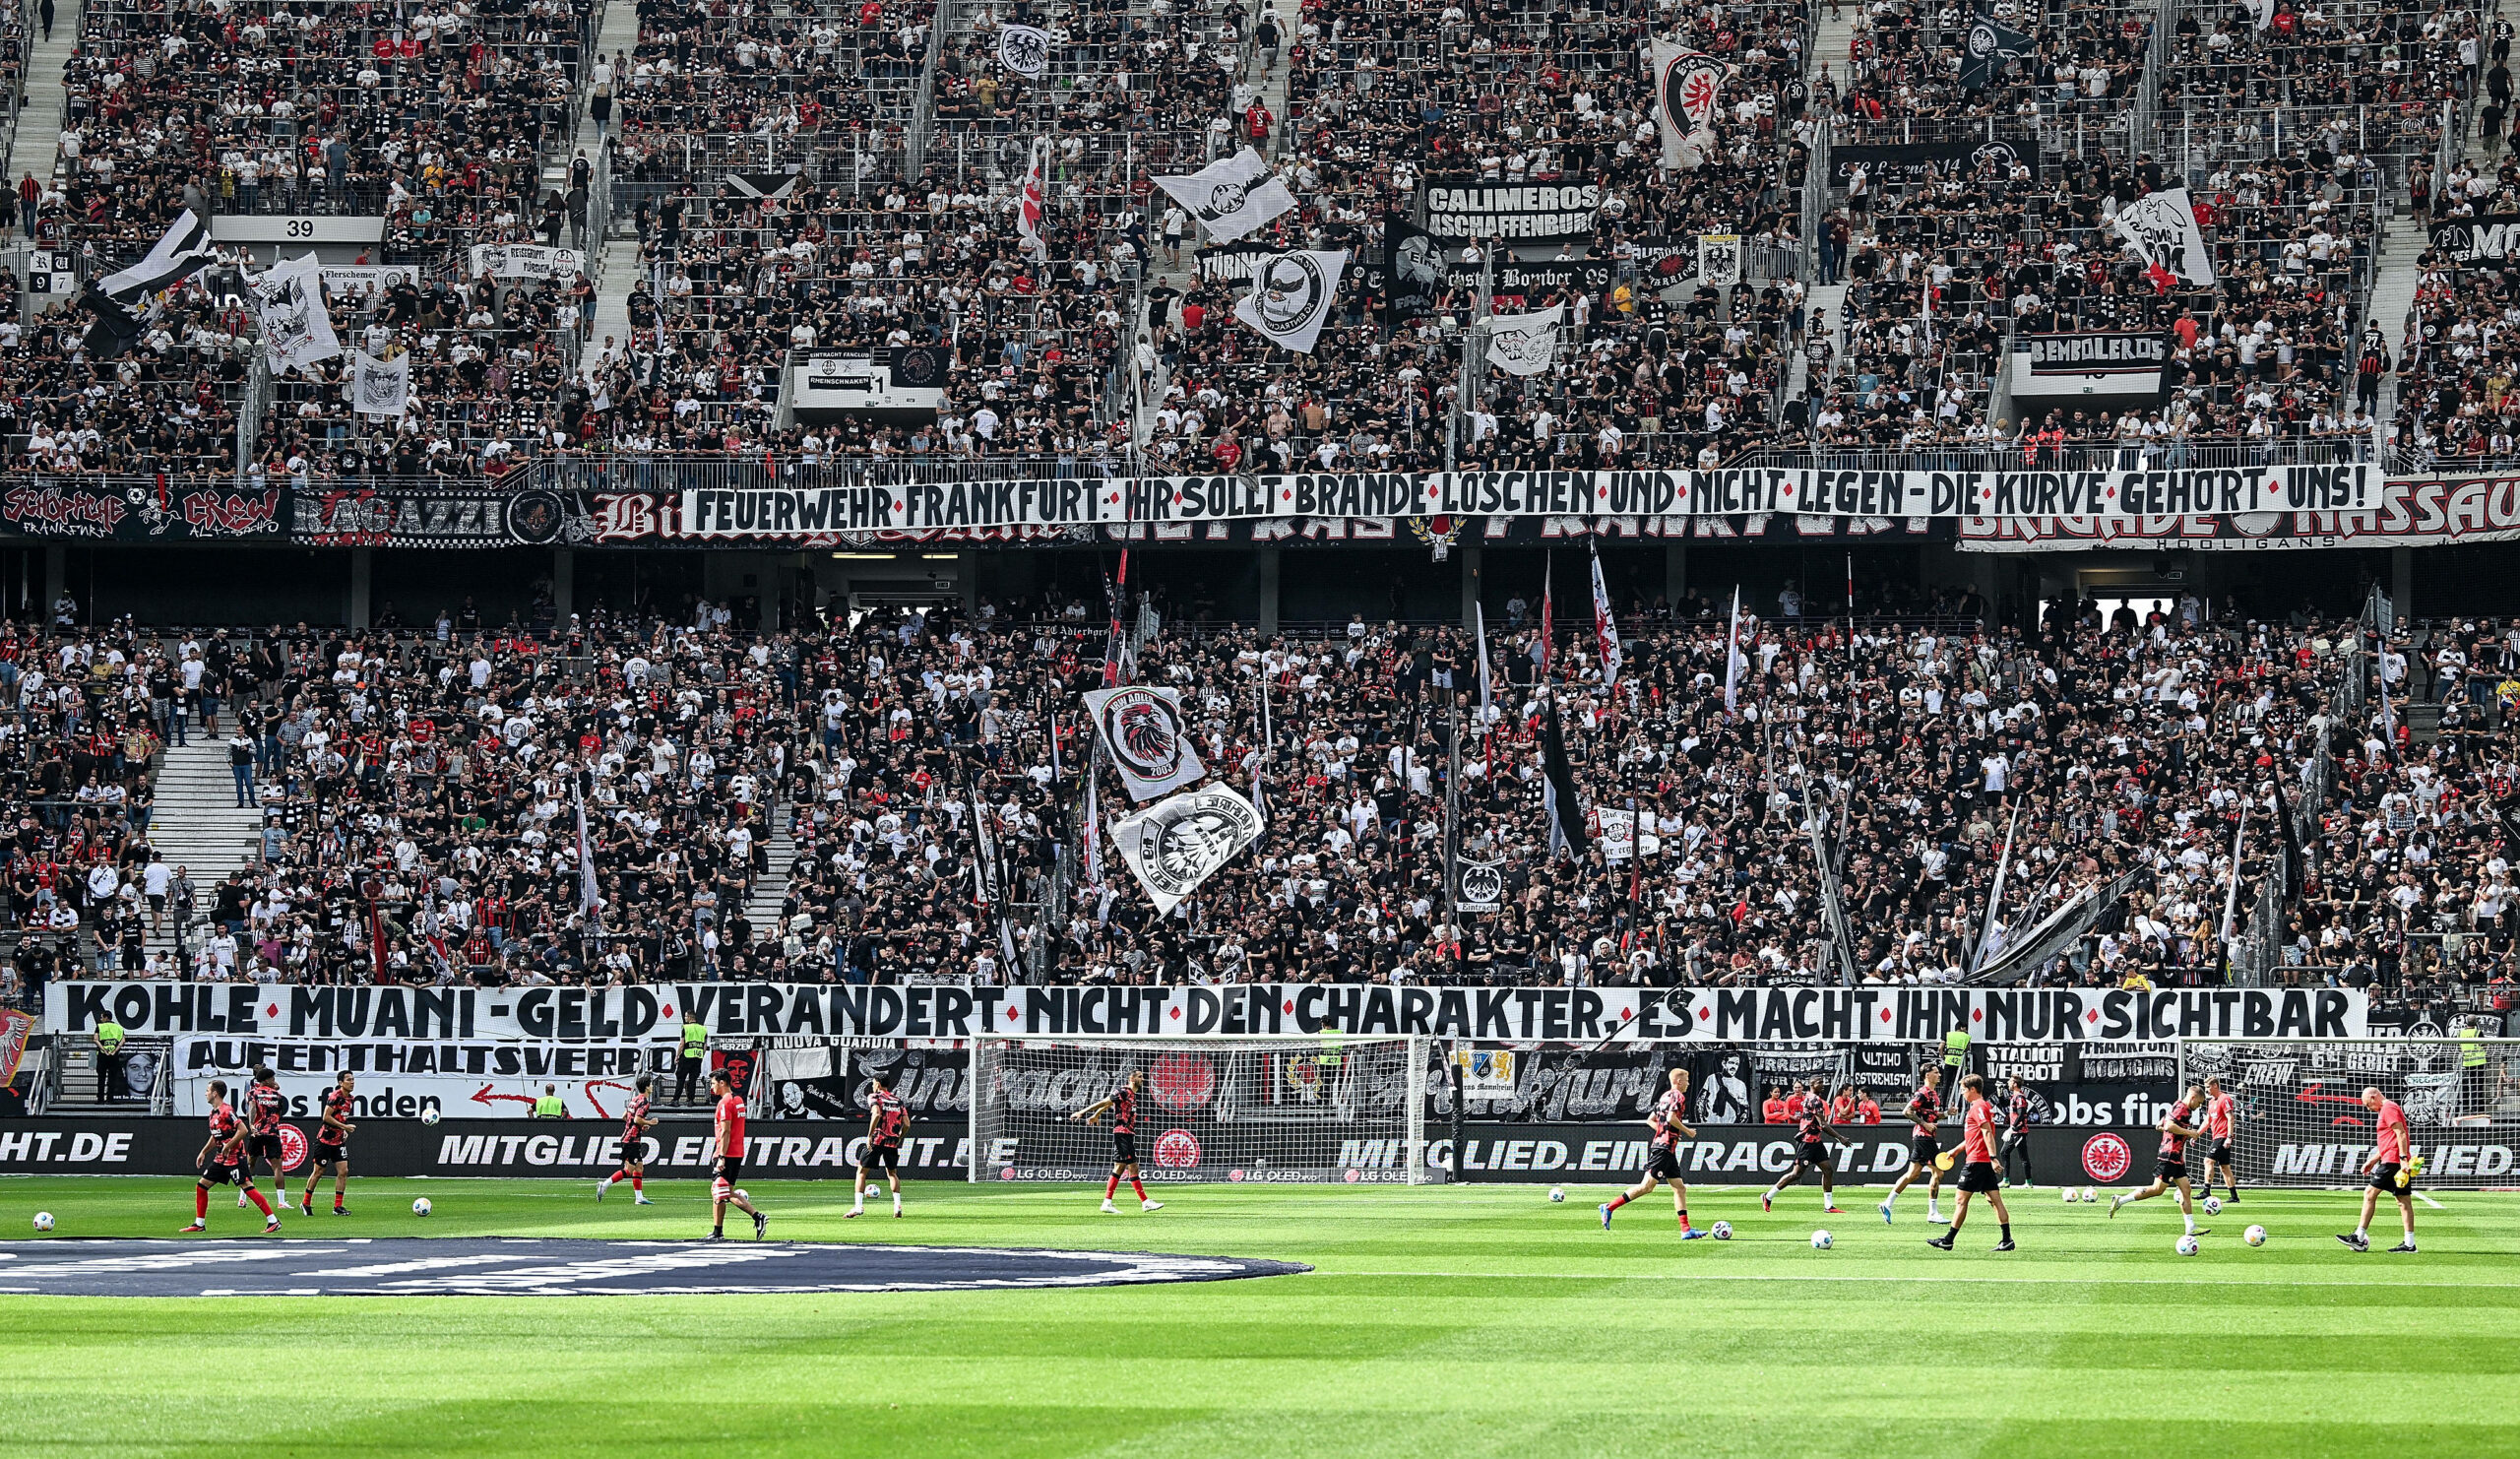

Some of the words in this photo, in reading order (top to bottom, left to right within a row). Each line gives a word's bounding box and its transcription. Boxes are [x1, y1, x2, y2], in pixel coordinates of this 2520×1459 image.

[1791, 86, 1802, 97] 30
[1428, 185, 1600, 212] CALIMEROS
[44, 225, 54, 237] 14
[286, 220, 314, 238] 39
[325, 270, 377, 280] Flerschemer
[2032, 337, 2164, 362] BEMBOLEROS
[2365, 336, 2378, 348] 27
[810, 377, 869, 386] RHEINSCHNAKEN
[696, 487, 893, 532] FEUERWEHR
[1124, 477, 1171, 521] IHR
[1180, 475, 1283, 518] SOLLT
[1294, 474, 1426, 516] BRÄNDE
[1440, 470, 1596, 514] LÖSCHEN
[1608, 470, 1674, 514] UND
[1690, 469, 1785, 514] NICHT
[1931, 473, 1981, 515] DIE
[1995, 473, 2107, 515] KURVE
[2120, 469, 2267, 514] GEHÖRT
[2287, 465, 2367, 509] UNS!
[3, 484, 128, 534] SCHÖPPCHE
[183, 489, 281, 532] CREW
[291, 497, 504, 535] RAGAZZI
[2156, 537, 2336, 550] HOOLIGANS
[1128, 690, 1155, 705] ADLER
[1150, 763, 1173, 777] 2003
[1462, 903, 1499, 913] Eintracht
[66, 984, 259, 1036] KOHLE
[676, 985, 1006, 1038] VERÄNDERT
[1026, 986, 1169, 1038] NICHT
[1187, 985, 1282, 1037] DEN
[1294, 986, 1617, 1040] CHARAKTER,
[1639, 987, 1692, 1039] ES
[1715, 988, 1879, 1041] MACHT
[1895, 990, 1970, 1041] IHN
[1984, 990, 2084, 1042] NUR
[2101, 990, 2350, 1040] SICHTBAR
[774, 1036, 822, 1049] NUOVA
[830, 1037, 897, 1049] GUARDIA
[1986, 1046, 2064, 1063] STADION
[2347, 1052, 2400, 1071] GEBIET
[1986, 1062, 2063, 1081] VERBOT
[2084, 1058, 2175, 1079] HOOLIGANS
[2243, 1063, 2296, 1085] CREW
[1018, 1168, 1034, 1179] LG
[1244, 1170, 1262, 1180] LG
[1360, 1170, 1376, 1180] LG
